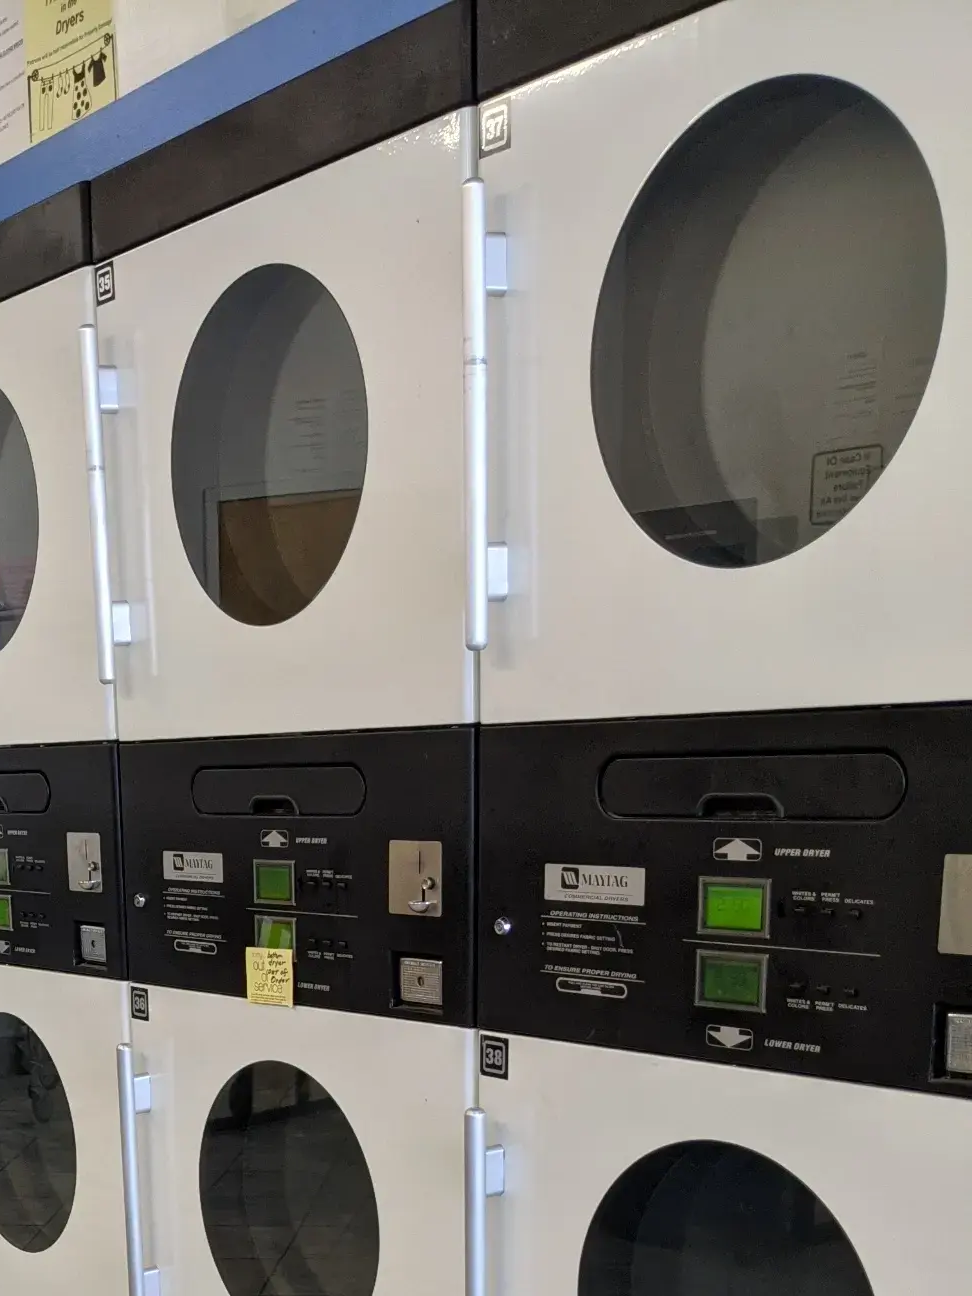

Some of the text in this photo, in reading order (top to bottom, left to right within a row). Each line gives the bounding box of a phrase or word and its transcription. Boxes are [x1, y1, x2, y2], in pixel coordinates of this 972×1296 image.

[60, 3, 67, 13] in
[55, 10, 84, 35] Dryers
[486, 115, 504, 140] 37
[99, 273, 110, 293] 35
[774, 847, 831, 858] UPPER DRYER
[185, 858, 213, 869] MAYTAG
[581, 873, 628, 888] MAYTAG
[549, 910, 639, 922] OPERATING INSTRUCTIONS
[554, 965, 581, 974] ENSURE
[581, 968, 610, 977] PROPER
[610, 971, 637, 980] DRYING
[134, 996, 145, 1011] 36
[764, 1038, 821, 1053] LOWER DRYER
[485, 1047, 503, 1066] 38
